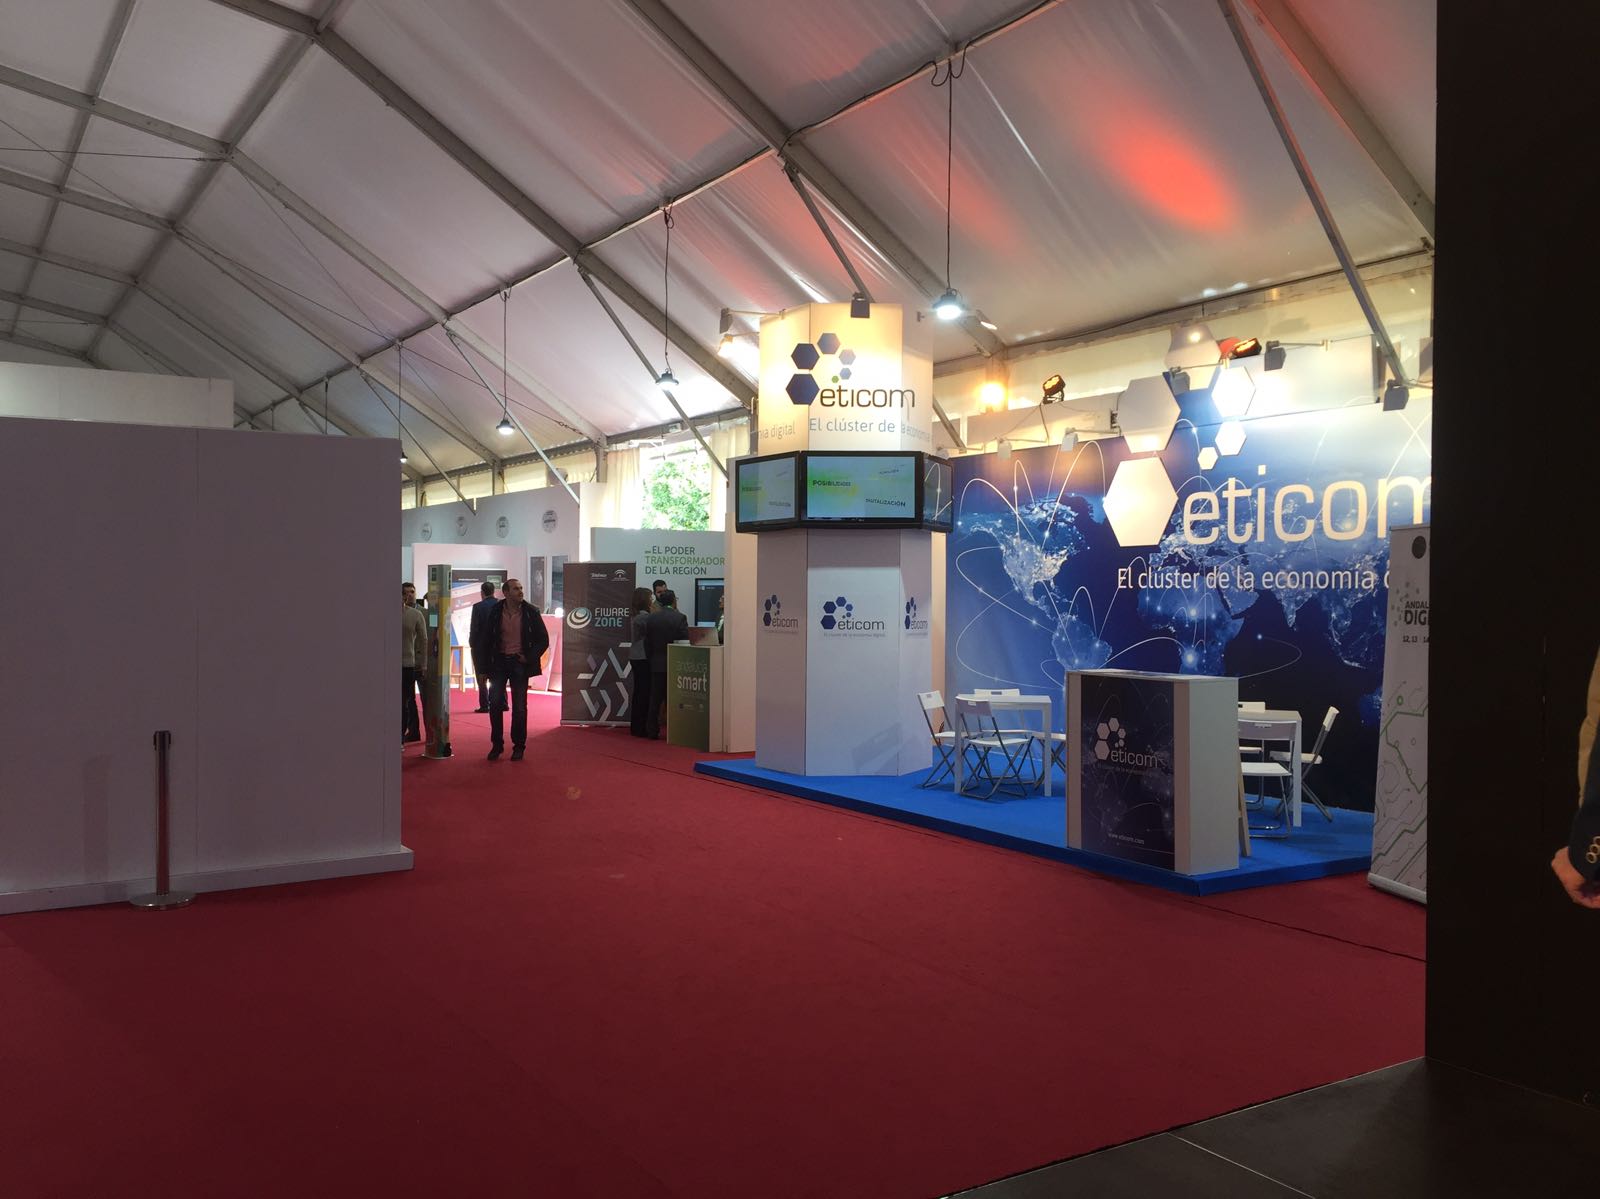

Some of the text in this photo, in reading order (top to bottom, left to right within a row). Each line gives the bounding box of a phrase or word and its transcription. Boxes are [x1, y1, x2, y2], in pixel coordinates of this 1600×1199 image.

[820, 385, 915, 408] eticom
[770, 420, 796, 440] digital
[809, 418, 821, 432] El
[826, 418, 874, 433] clúster
[878, 418, 895, 433] de
[1183, 464, 1432, 545] eticom
[664, 546, 695, 556] PODER
[645, 556, 724, 566] TRANSFORMADOR
[645, 565, 707, 576] DE LA REGIÓN
[1117, 567, 1133, 589] El
[1138, 566, 1200, 589] clúster
[1205, 567, 1230, 589] de
[1237, 566, 1254, 589] la
[1261, 564, 1376, 589] economía
[595, 607, 630, 617] FIWARE
[595, 617, 623, 628] ZONE
[772, 617, 799, 629] eticom
[837, 618, 885, 631] eticom
[677, 673, 708, 692] smart
[1110, 749, 1158, 768] eticom
